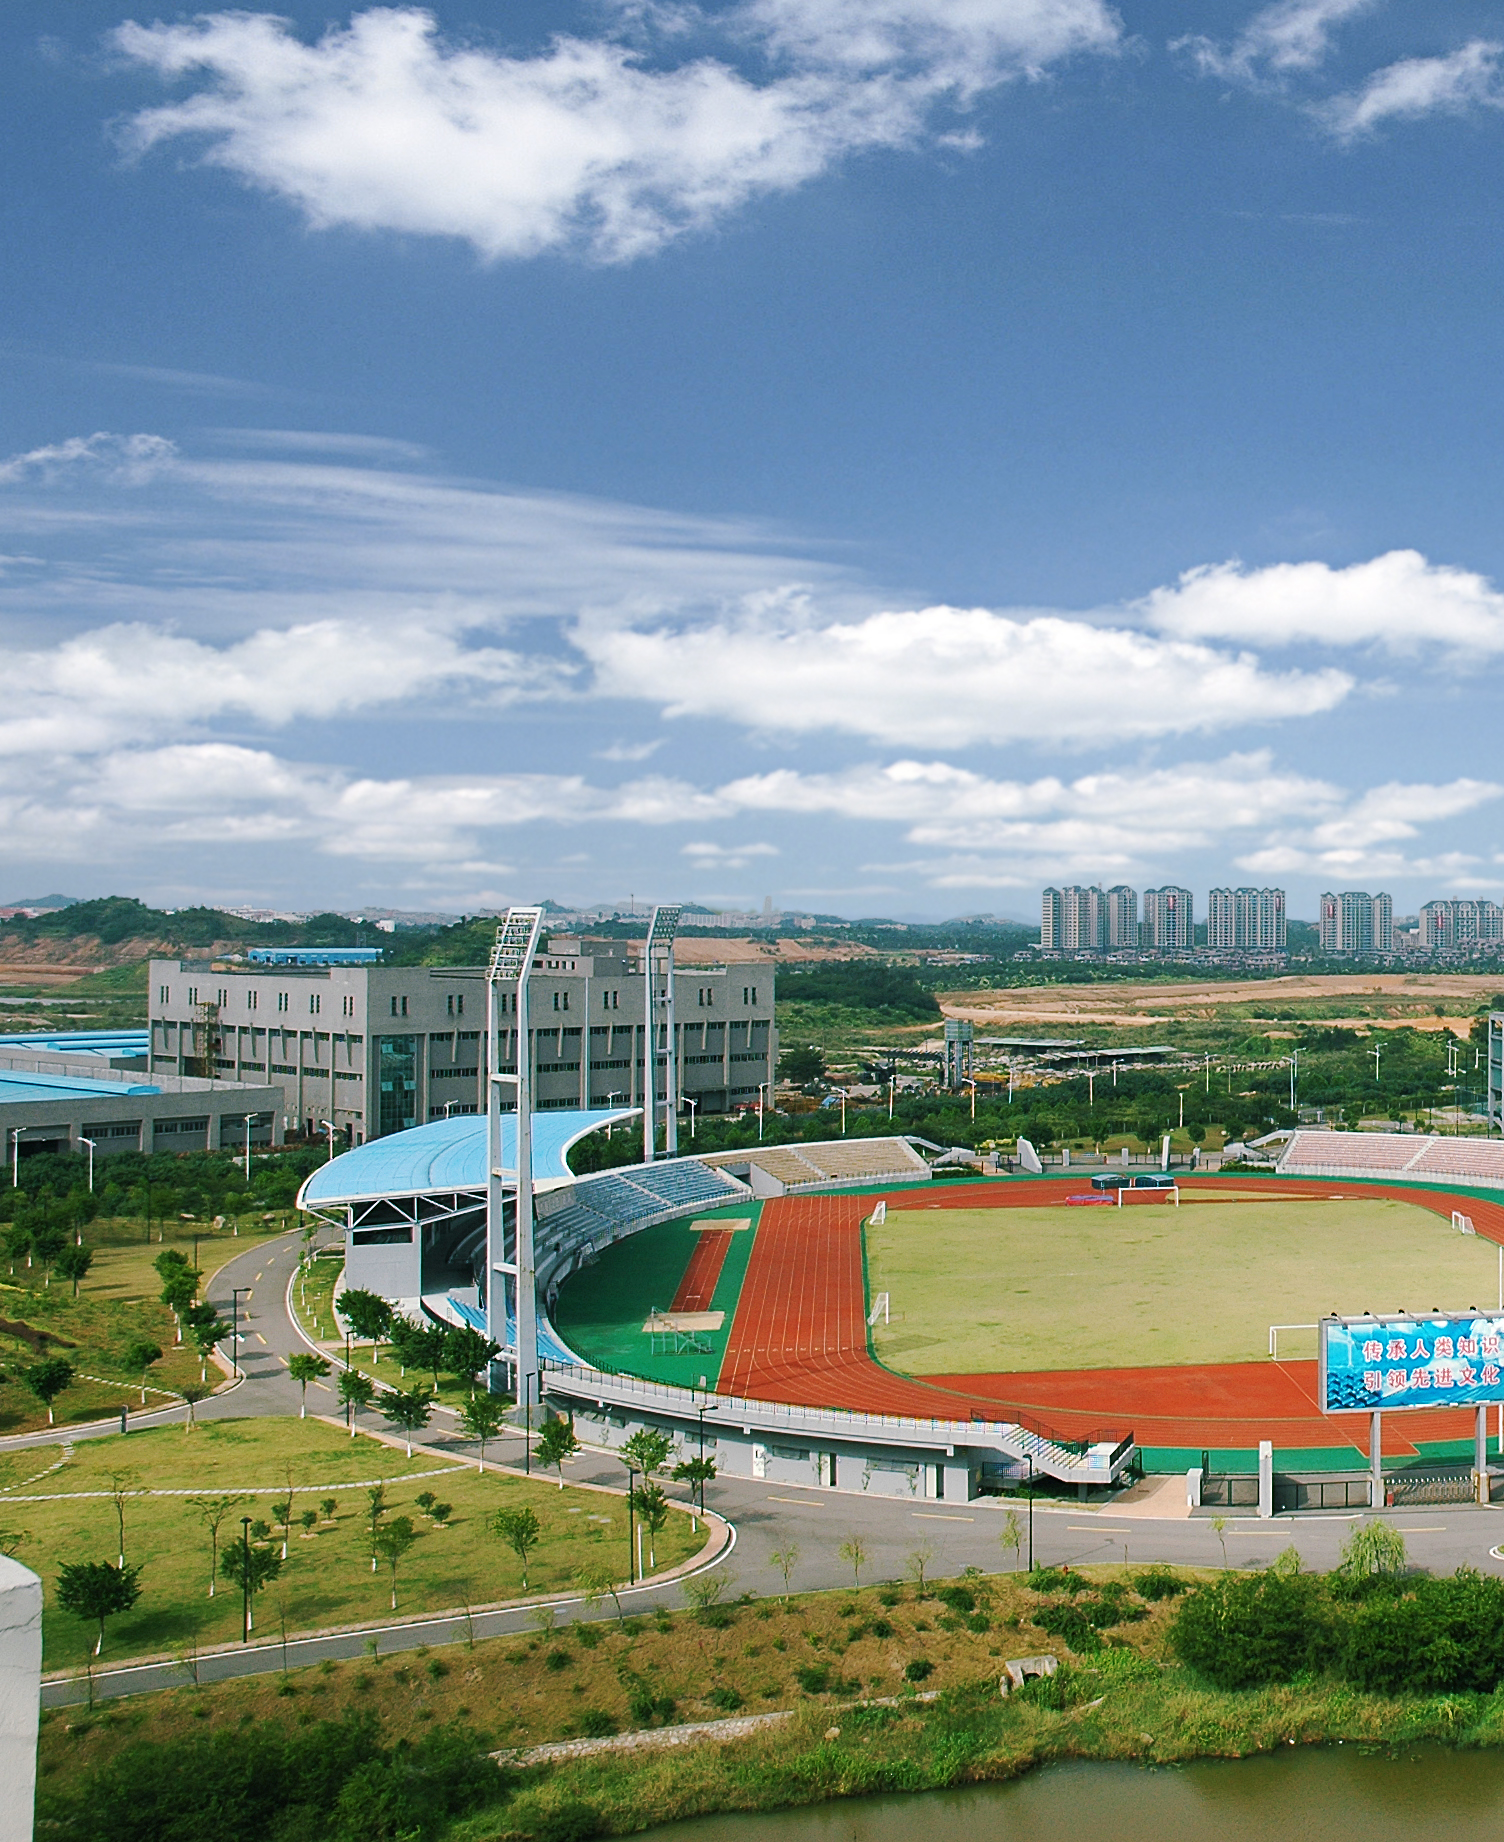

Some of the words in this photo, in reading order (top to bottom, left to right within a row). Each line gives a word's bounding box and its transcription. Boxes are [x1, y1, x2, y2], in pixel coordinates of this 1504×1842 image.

[1363, 1336, 1500, 1361] 传承人类知识
[1364, 1366, 1500, 1390] 引领先进文化
